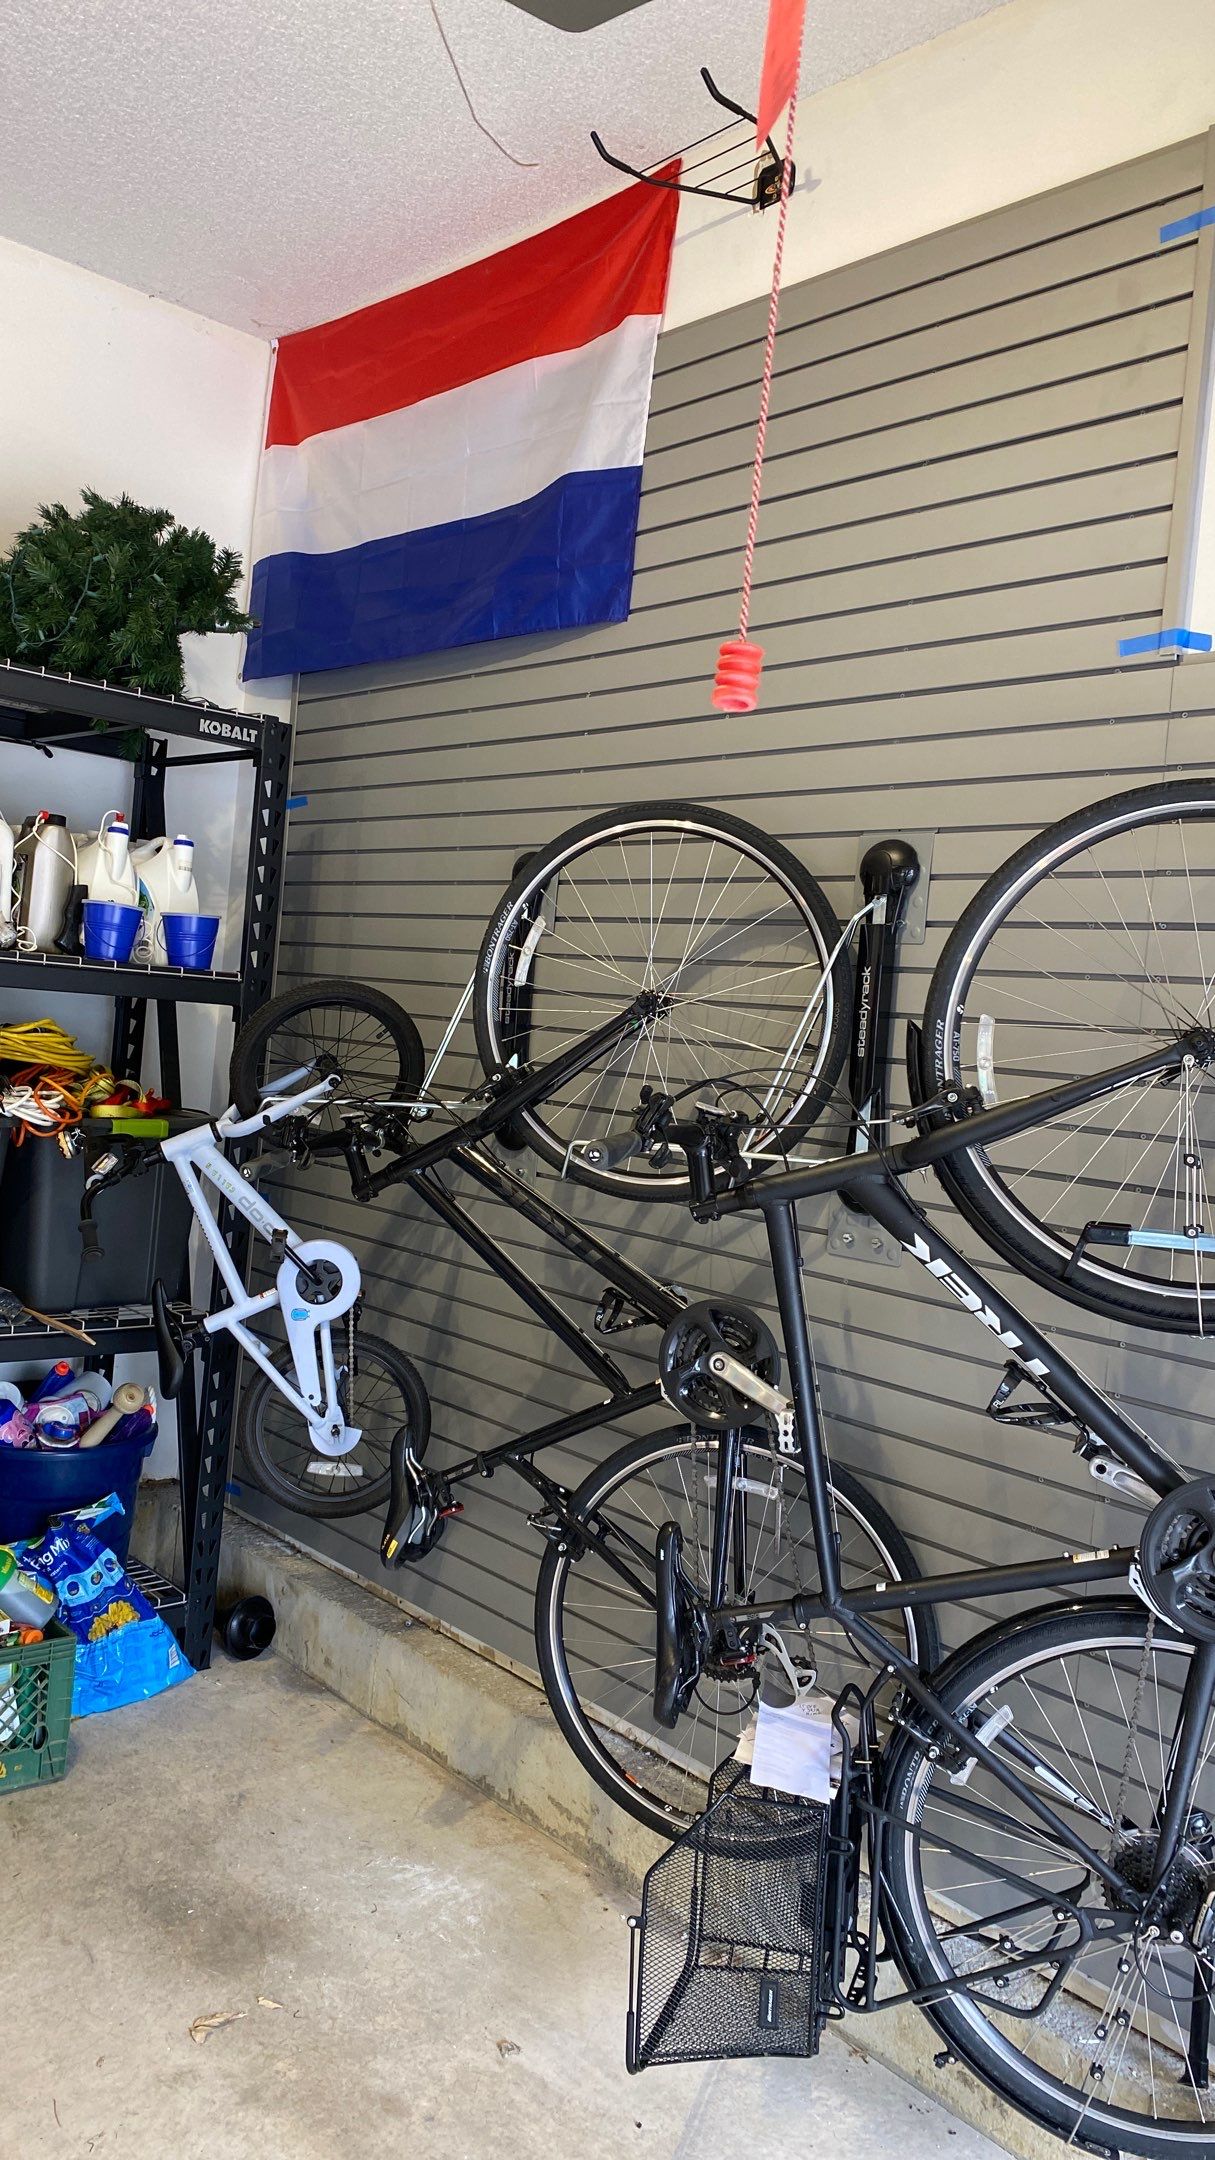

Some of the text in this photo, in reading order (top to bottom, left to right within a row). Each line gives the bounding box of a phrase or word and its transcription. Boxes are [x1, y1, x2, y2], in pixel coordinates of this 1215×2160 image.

[199, 718, 258, 743] KOBALT
[484, 901, 514, 964] BONTRAGER
[857, 966, 872, 1058] steadyrack
[953, 1030, 961, 1062] AT-750
[900, 1232, 1051, 1376] TREK
